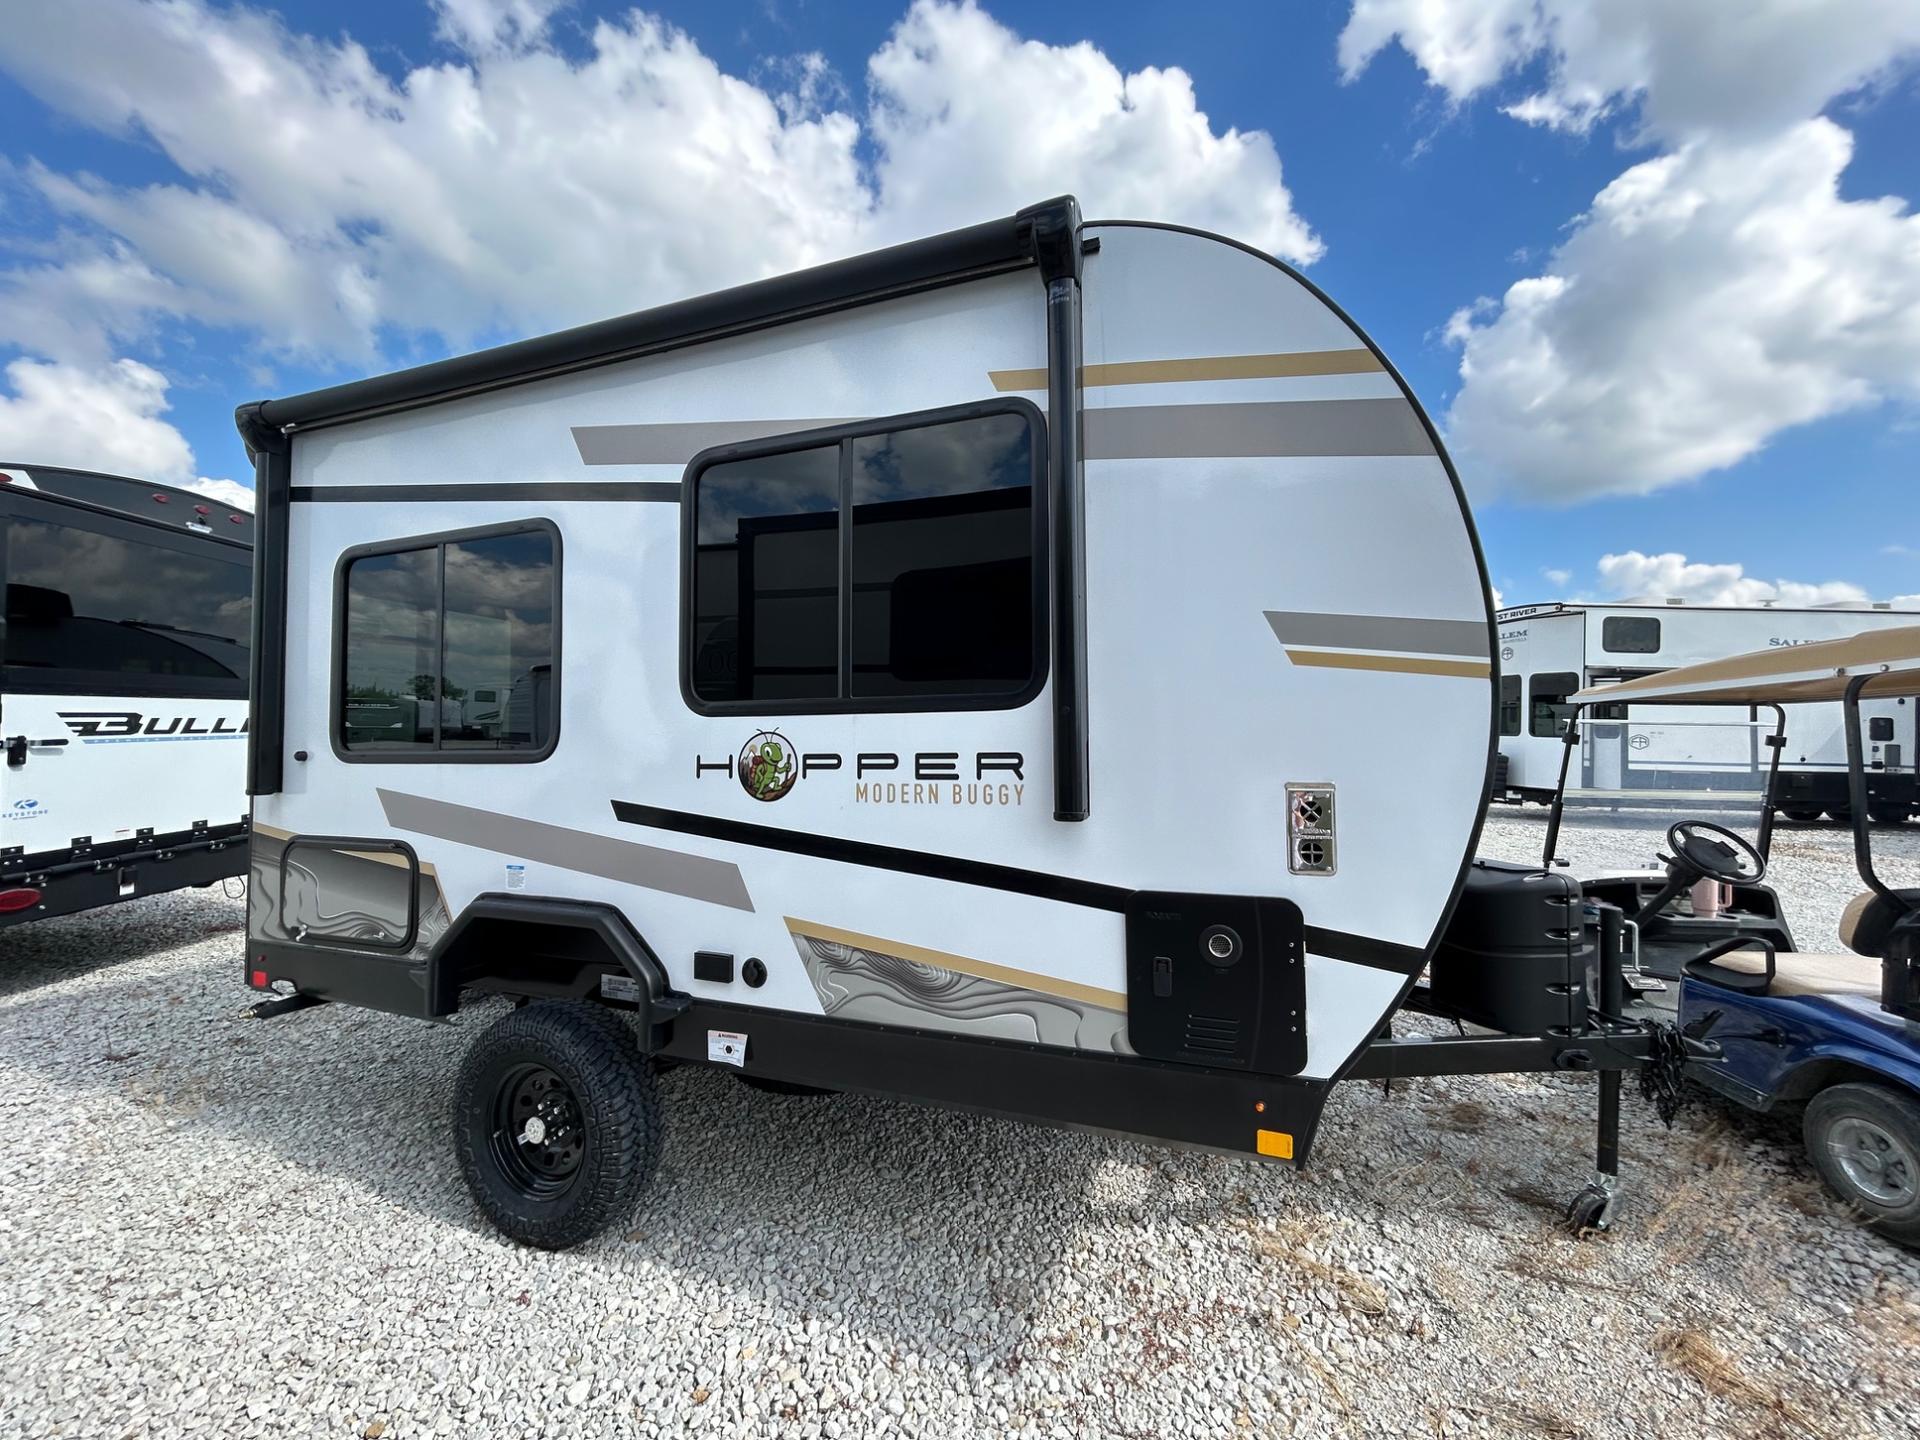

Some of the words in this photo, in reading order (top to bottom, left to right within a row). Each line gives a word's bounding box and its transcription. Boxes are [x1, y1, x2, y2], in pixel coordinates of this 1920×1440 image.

[1510, 608, 1536, 617] RIVER
[1498, 630, 1528, 639] LEM
[1769, 638, 1817, 646] SAL
[855, 782, 939, 804] MODERN
[952, 783, 1025, 806] BUGGY
[2, 809, 49, 818] KEYSTONE
